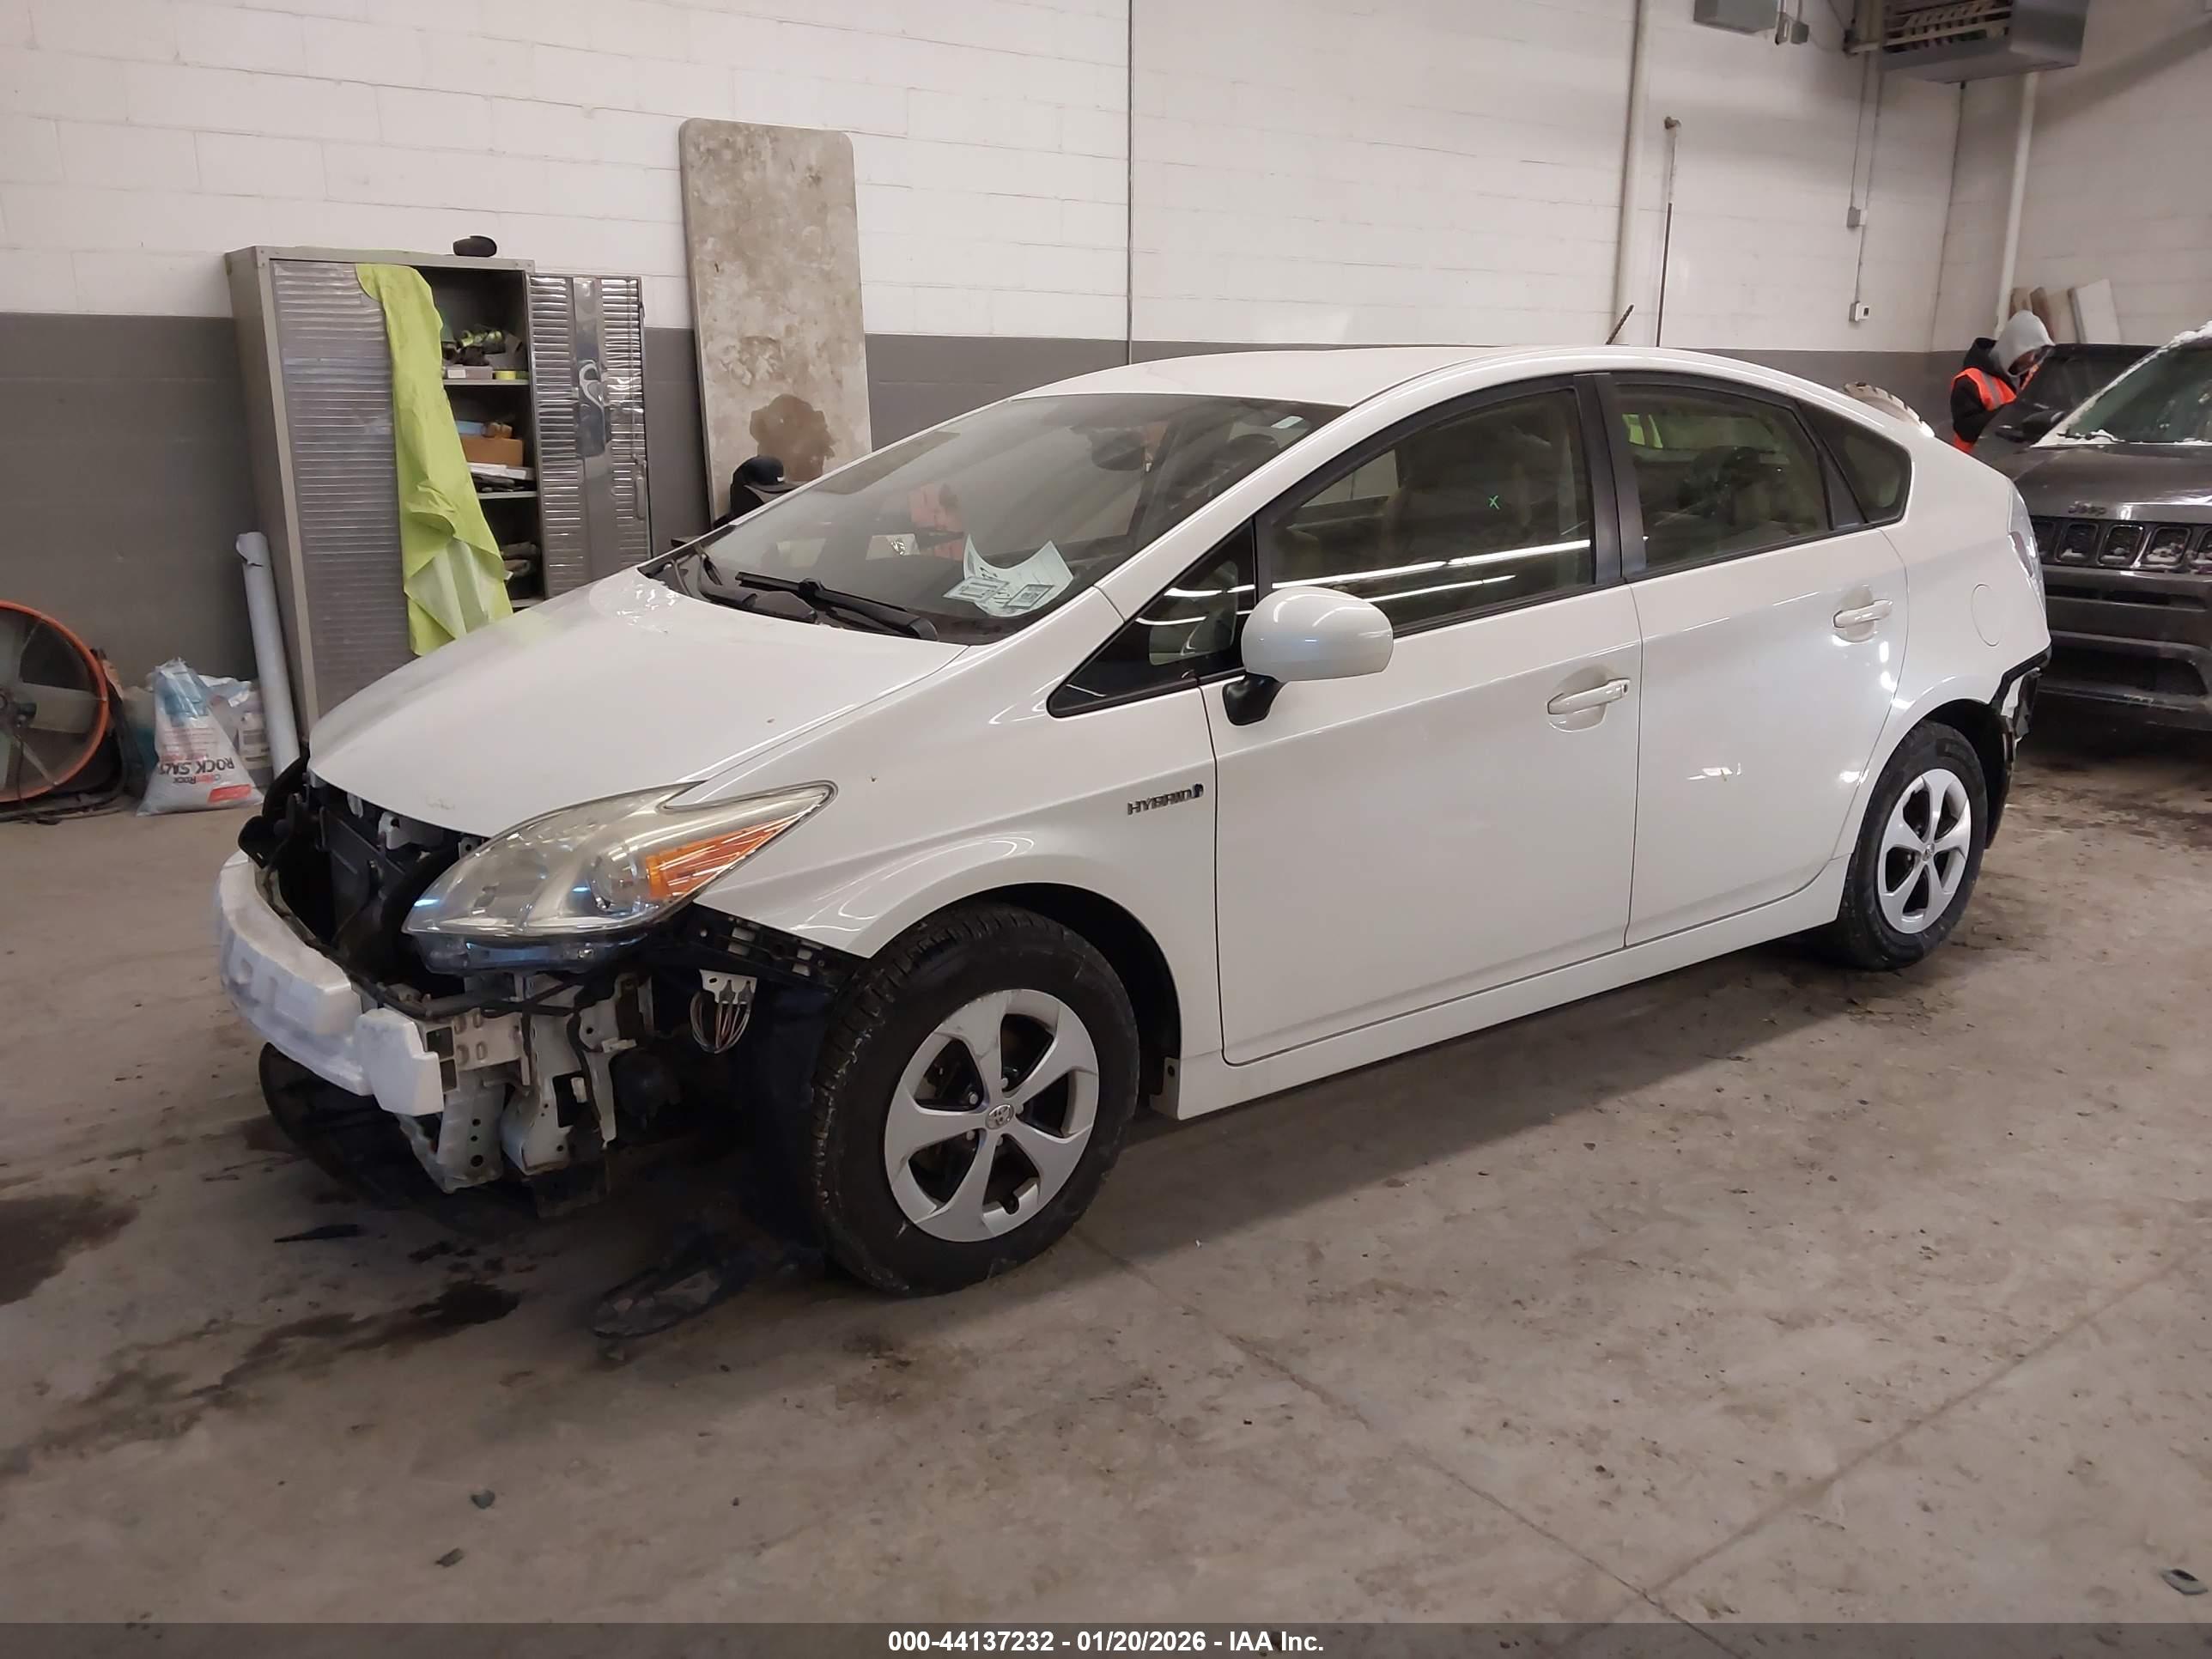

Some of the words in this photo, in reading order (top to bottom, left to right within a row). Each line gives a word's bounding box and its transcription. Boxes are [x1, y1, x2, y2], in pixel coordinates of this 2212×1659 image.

[2068, 501, 2107, 517] Jeep
[195, 757, 235, 775] ROCK
[1127, 788, 1193, 816] HYBRID
